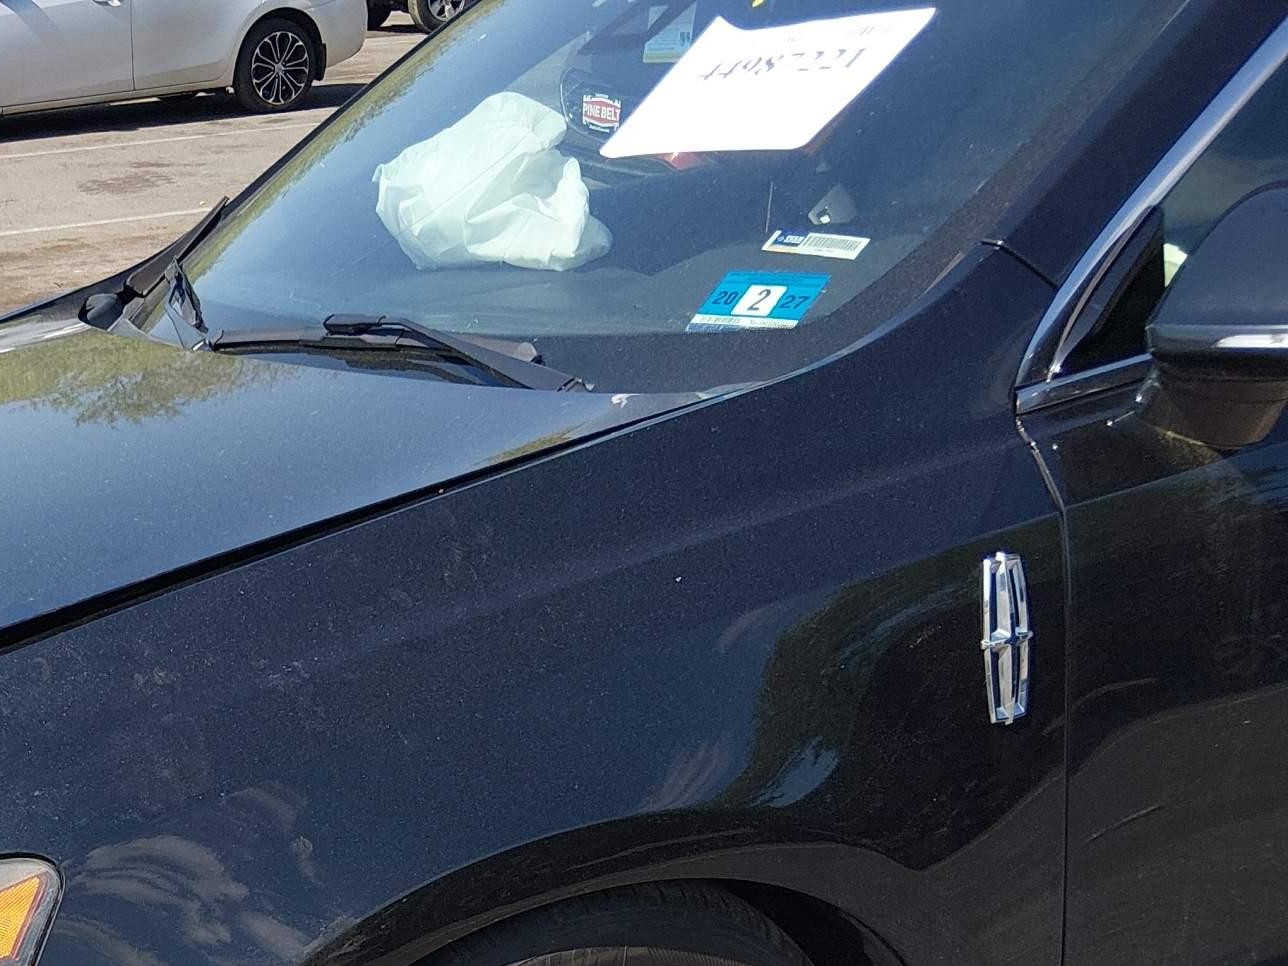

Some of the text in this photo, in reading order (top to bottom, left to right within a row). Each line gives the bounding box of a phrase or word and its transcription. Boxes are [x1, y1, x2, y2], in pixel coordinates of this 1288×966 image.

[583, 102, 620, 121] PINE BELT
[712, 288, 810, 312] 20 2 27
